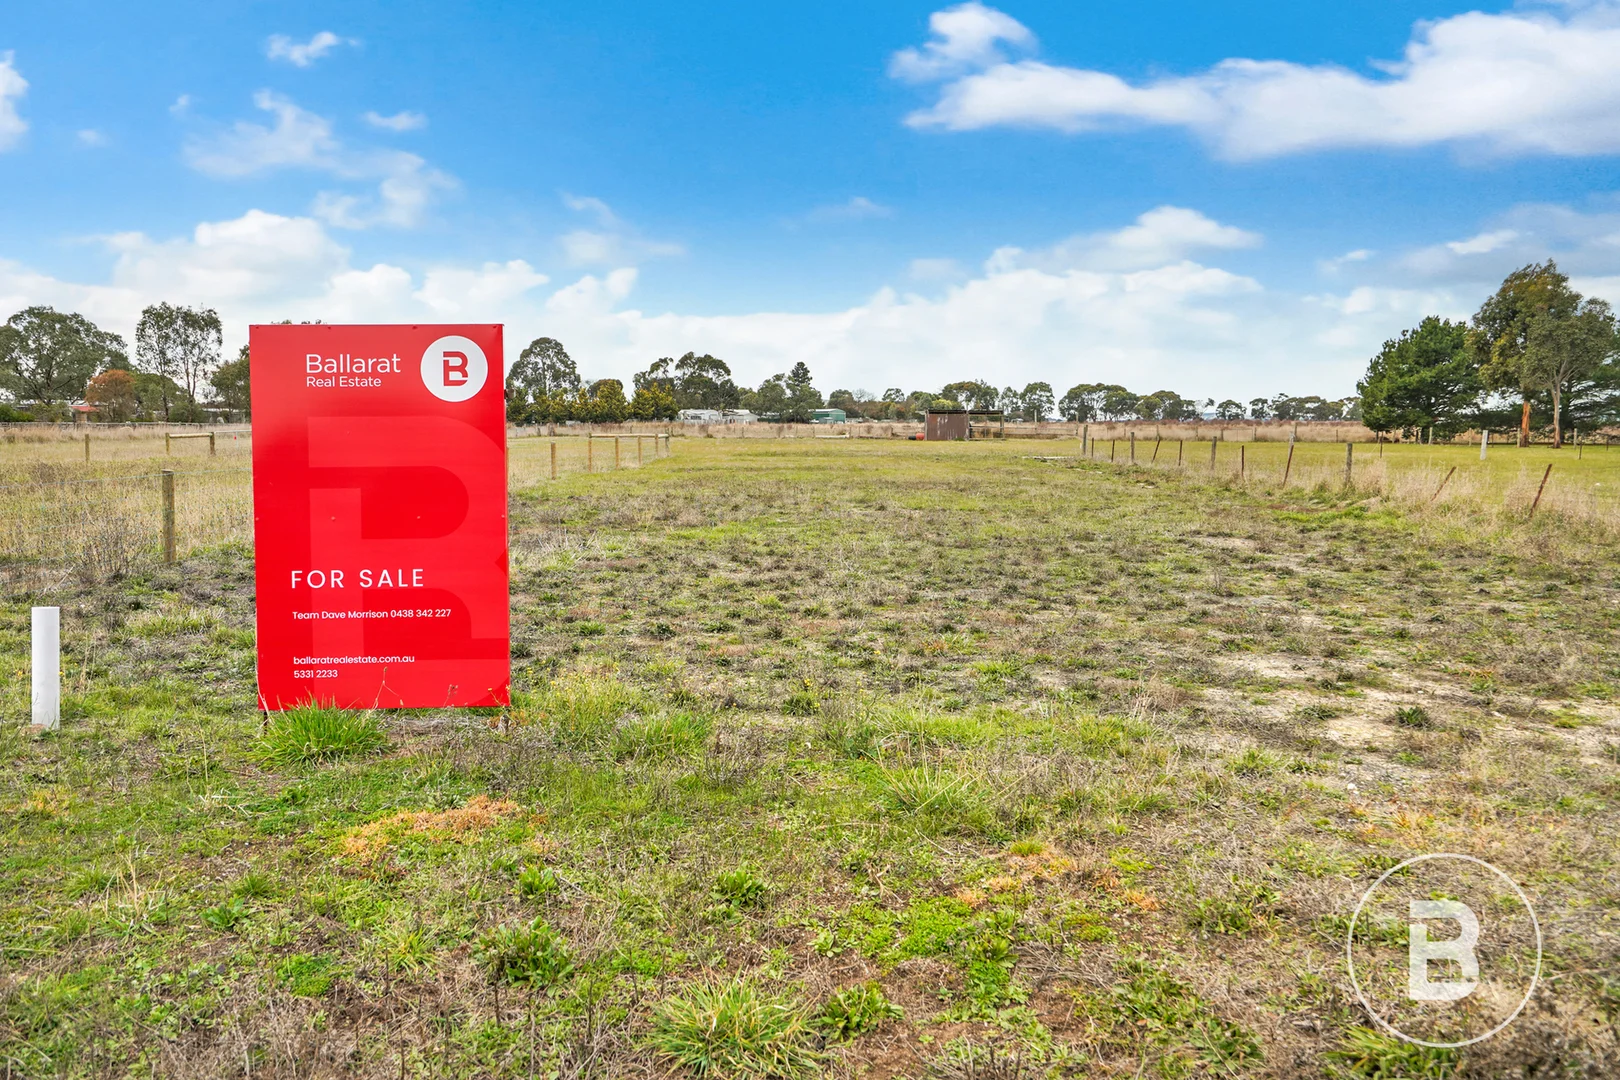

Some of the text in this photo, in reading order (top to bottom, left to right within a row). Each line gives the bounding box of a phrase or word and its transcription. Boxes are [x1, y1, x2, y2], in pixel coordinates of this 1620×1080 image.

[306, 353, 401, 374] Ballarat
[443, 351, 469, 387] B
[306, 376, 382, 388] Real Estate
[291, 568, 424, 589] FOR SALE
[292, 608, 452, 620] Team Dave Morrison 0438 342 227
[293, 655, 415, 665] ballaratrealestate.com.au
[293, 669, 339, 679] 5331 2233
